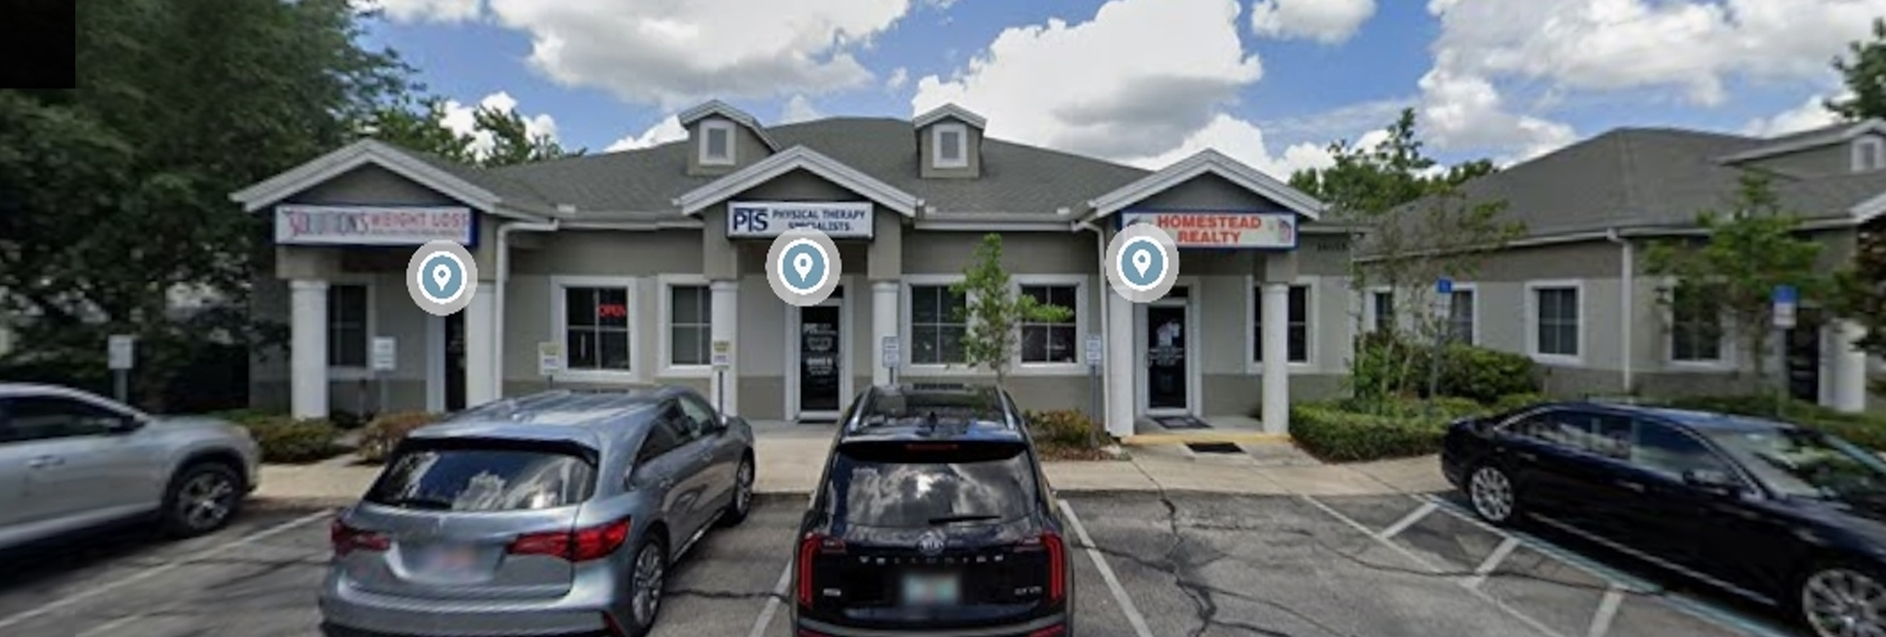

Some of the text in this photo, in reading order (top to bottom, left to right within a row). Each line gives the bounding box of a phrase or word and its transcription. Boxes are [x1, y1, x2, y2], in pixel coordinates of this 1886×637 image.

[370, 211, 427, 229] WEIGHT
[733, 207, 769, 232] PTS
[772, 209, 866, 220] PHYSICAL THERAPY
[1157, 215, 1262, 230] HOMESTEAD
[1177, 231, 1241, 243] REALTY
[598, 304, 626, 318] OPEN
